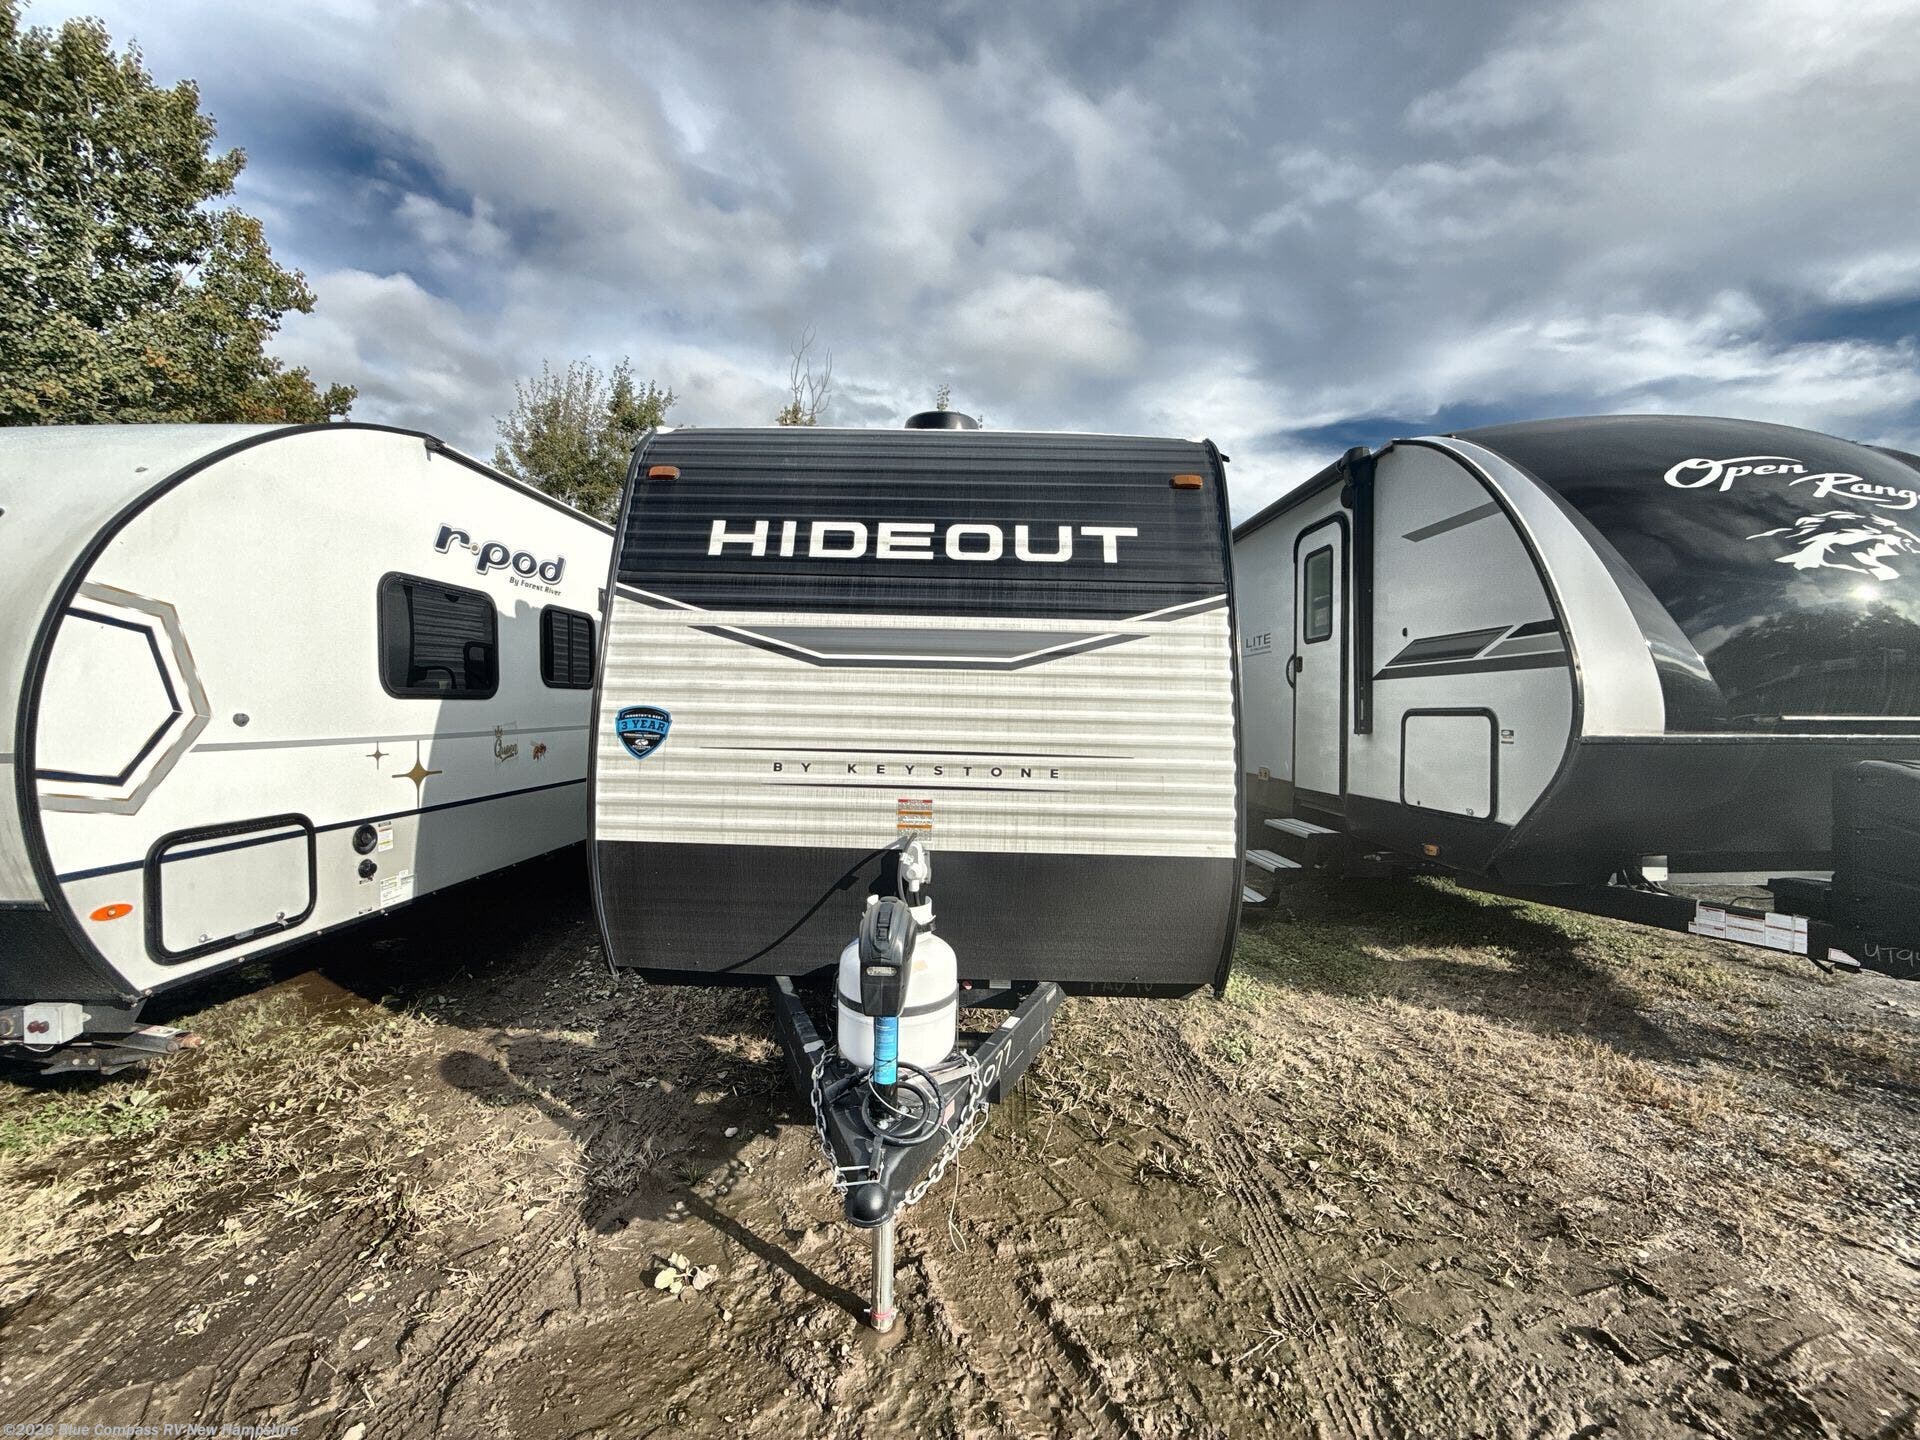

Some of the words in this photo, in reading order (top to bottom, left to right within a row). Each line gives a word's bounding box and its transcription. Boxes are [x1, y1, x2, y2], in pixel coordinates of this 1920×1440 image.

[1664, 456, 1808, 492] Open
[1789, 473, 1920, 510] Rang
[707, 519, 1138, 564] HIDEOUT
[509, 576, 519, 587] By
[520, 579, 544, 592] Forest
[544, 586, 562, 596] River
[1245, 632, 1271, 649] LITE
[621, 720, 628, 730] 3
[631, 719, 666, 732] YEAR
[773, 762, 812, 773] BY
[847, 763, 1060, 779] KEYSTONE
